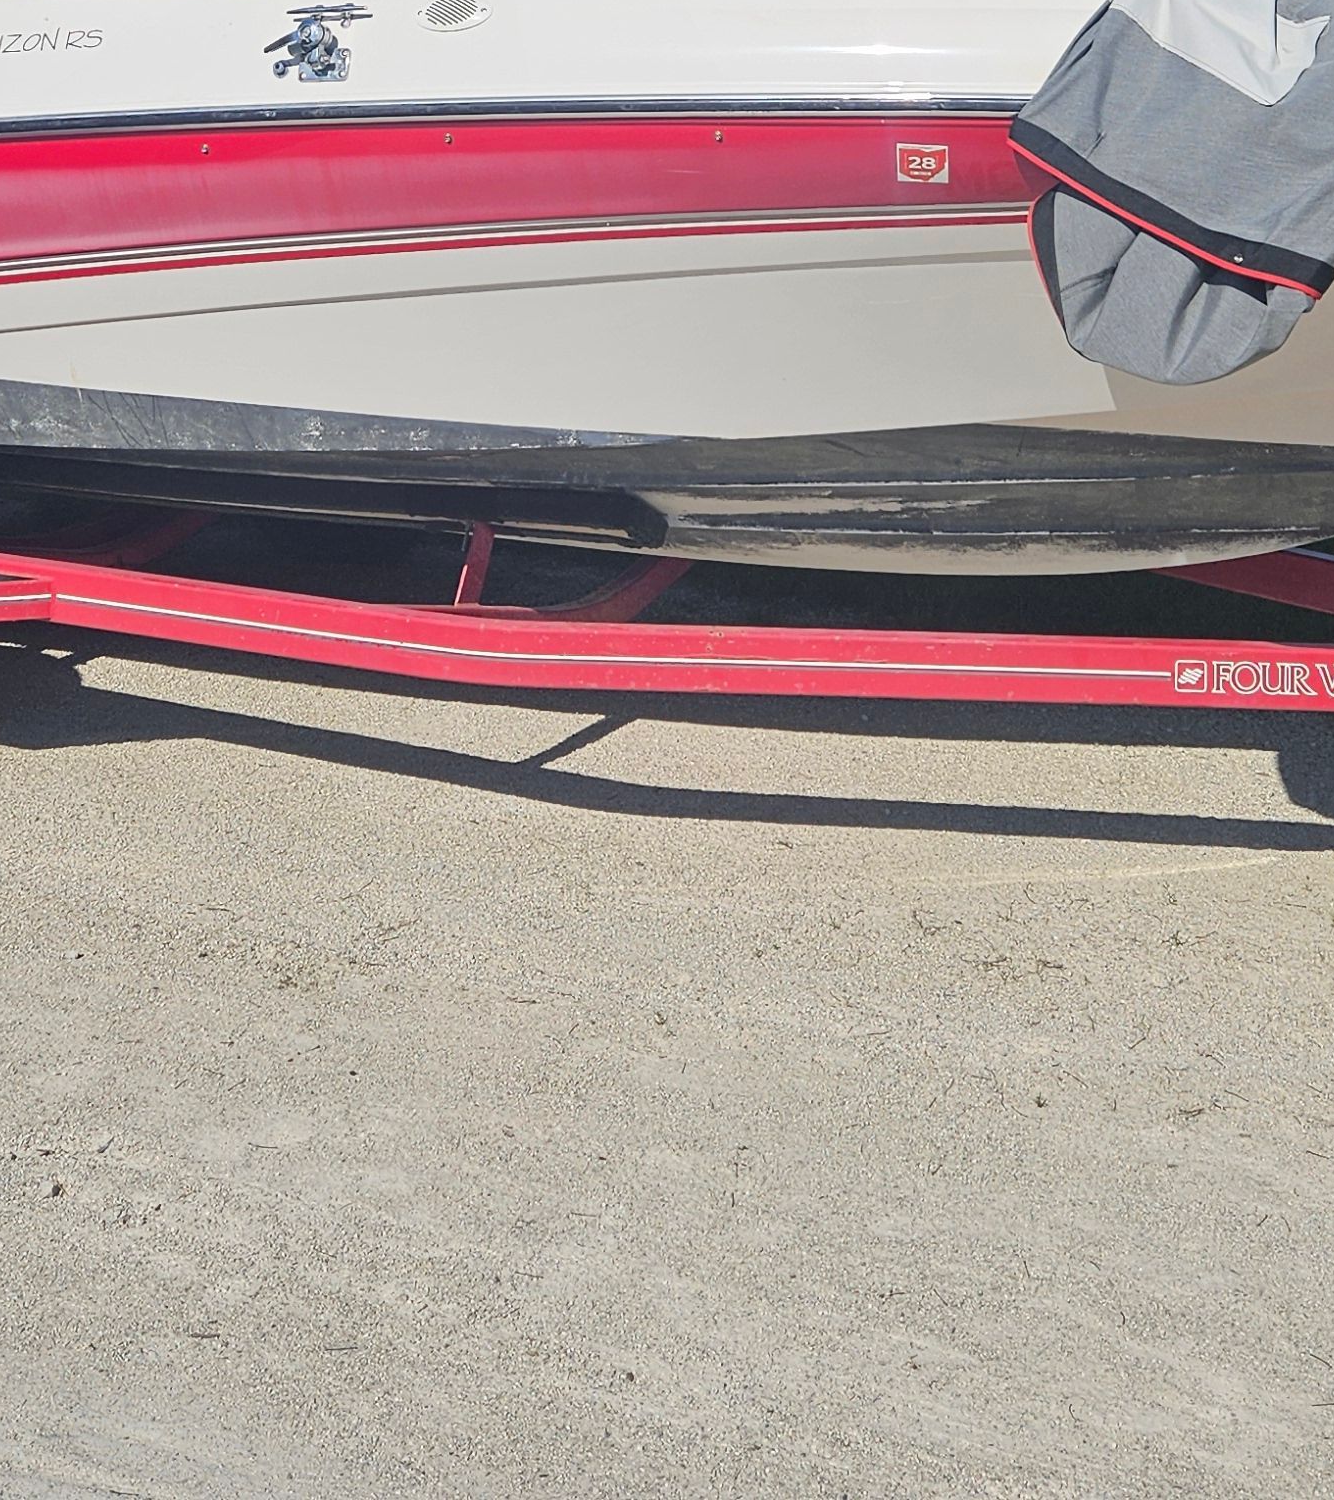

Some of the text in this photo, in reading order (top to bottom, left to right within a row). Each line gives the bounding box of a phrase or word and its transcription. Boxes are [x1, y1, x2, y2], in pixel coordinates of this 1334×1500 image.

[65, 29, 103, 50] RS
[907, 156, 936, 170] 28
[1211, 660, 1317, 696] FOUR
